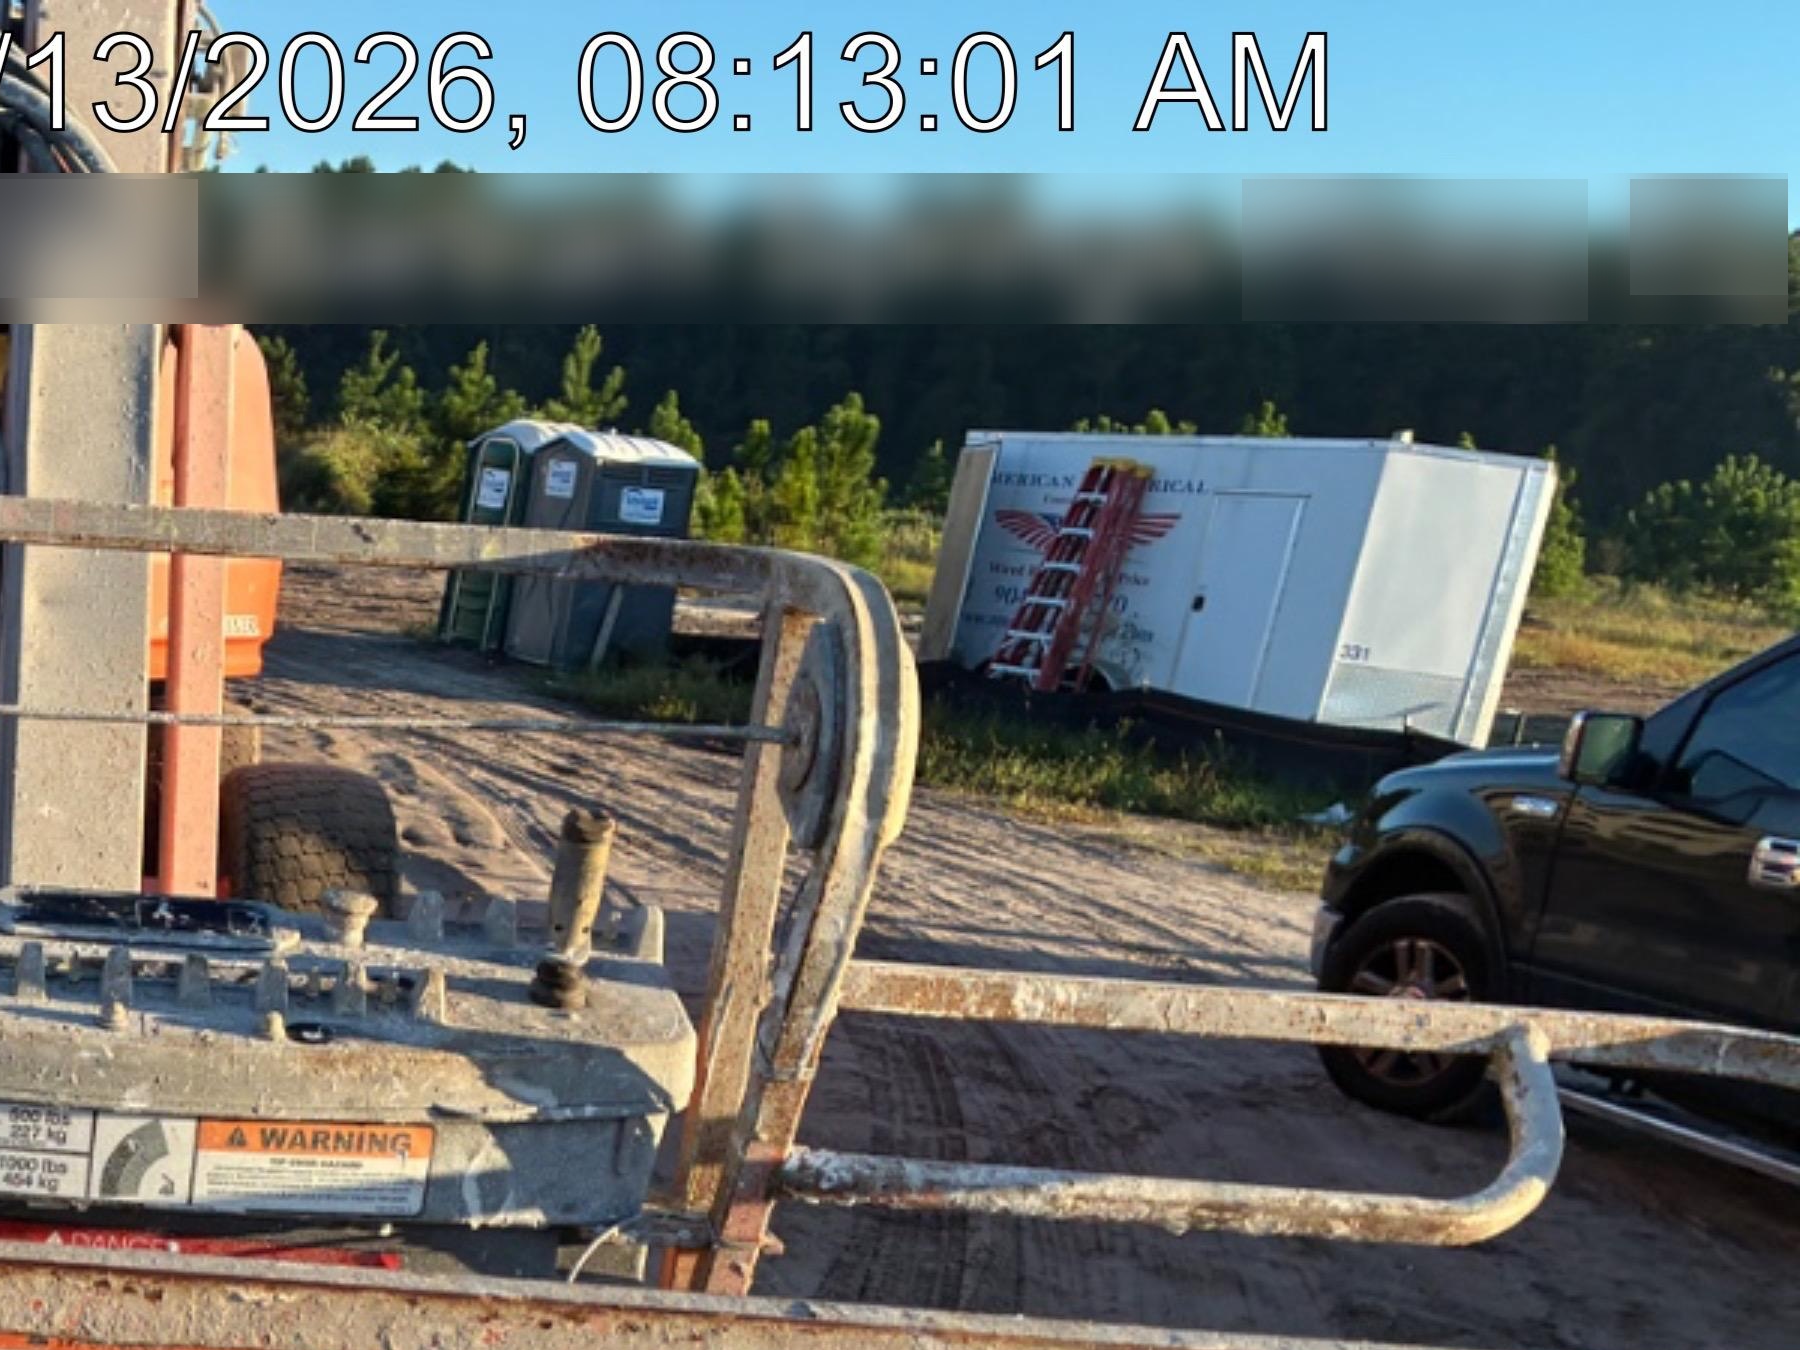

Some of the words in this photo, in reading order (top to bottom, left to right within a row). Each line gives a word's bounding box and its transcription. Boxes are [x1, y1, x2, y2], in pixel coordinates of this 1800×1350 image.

[992, 471, 1074, 489] MERICAN
[47, 1128, 67, 1144] kg
[260, 1126, 413, 1154] WARNING
[41, 1157, 69, 1175] lbs
[37, 1174, 60, 1193] kg
